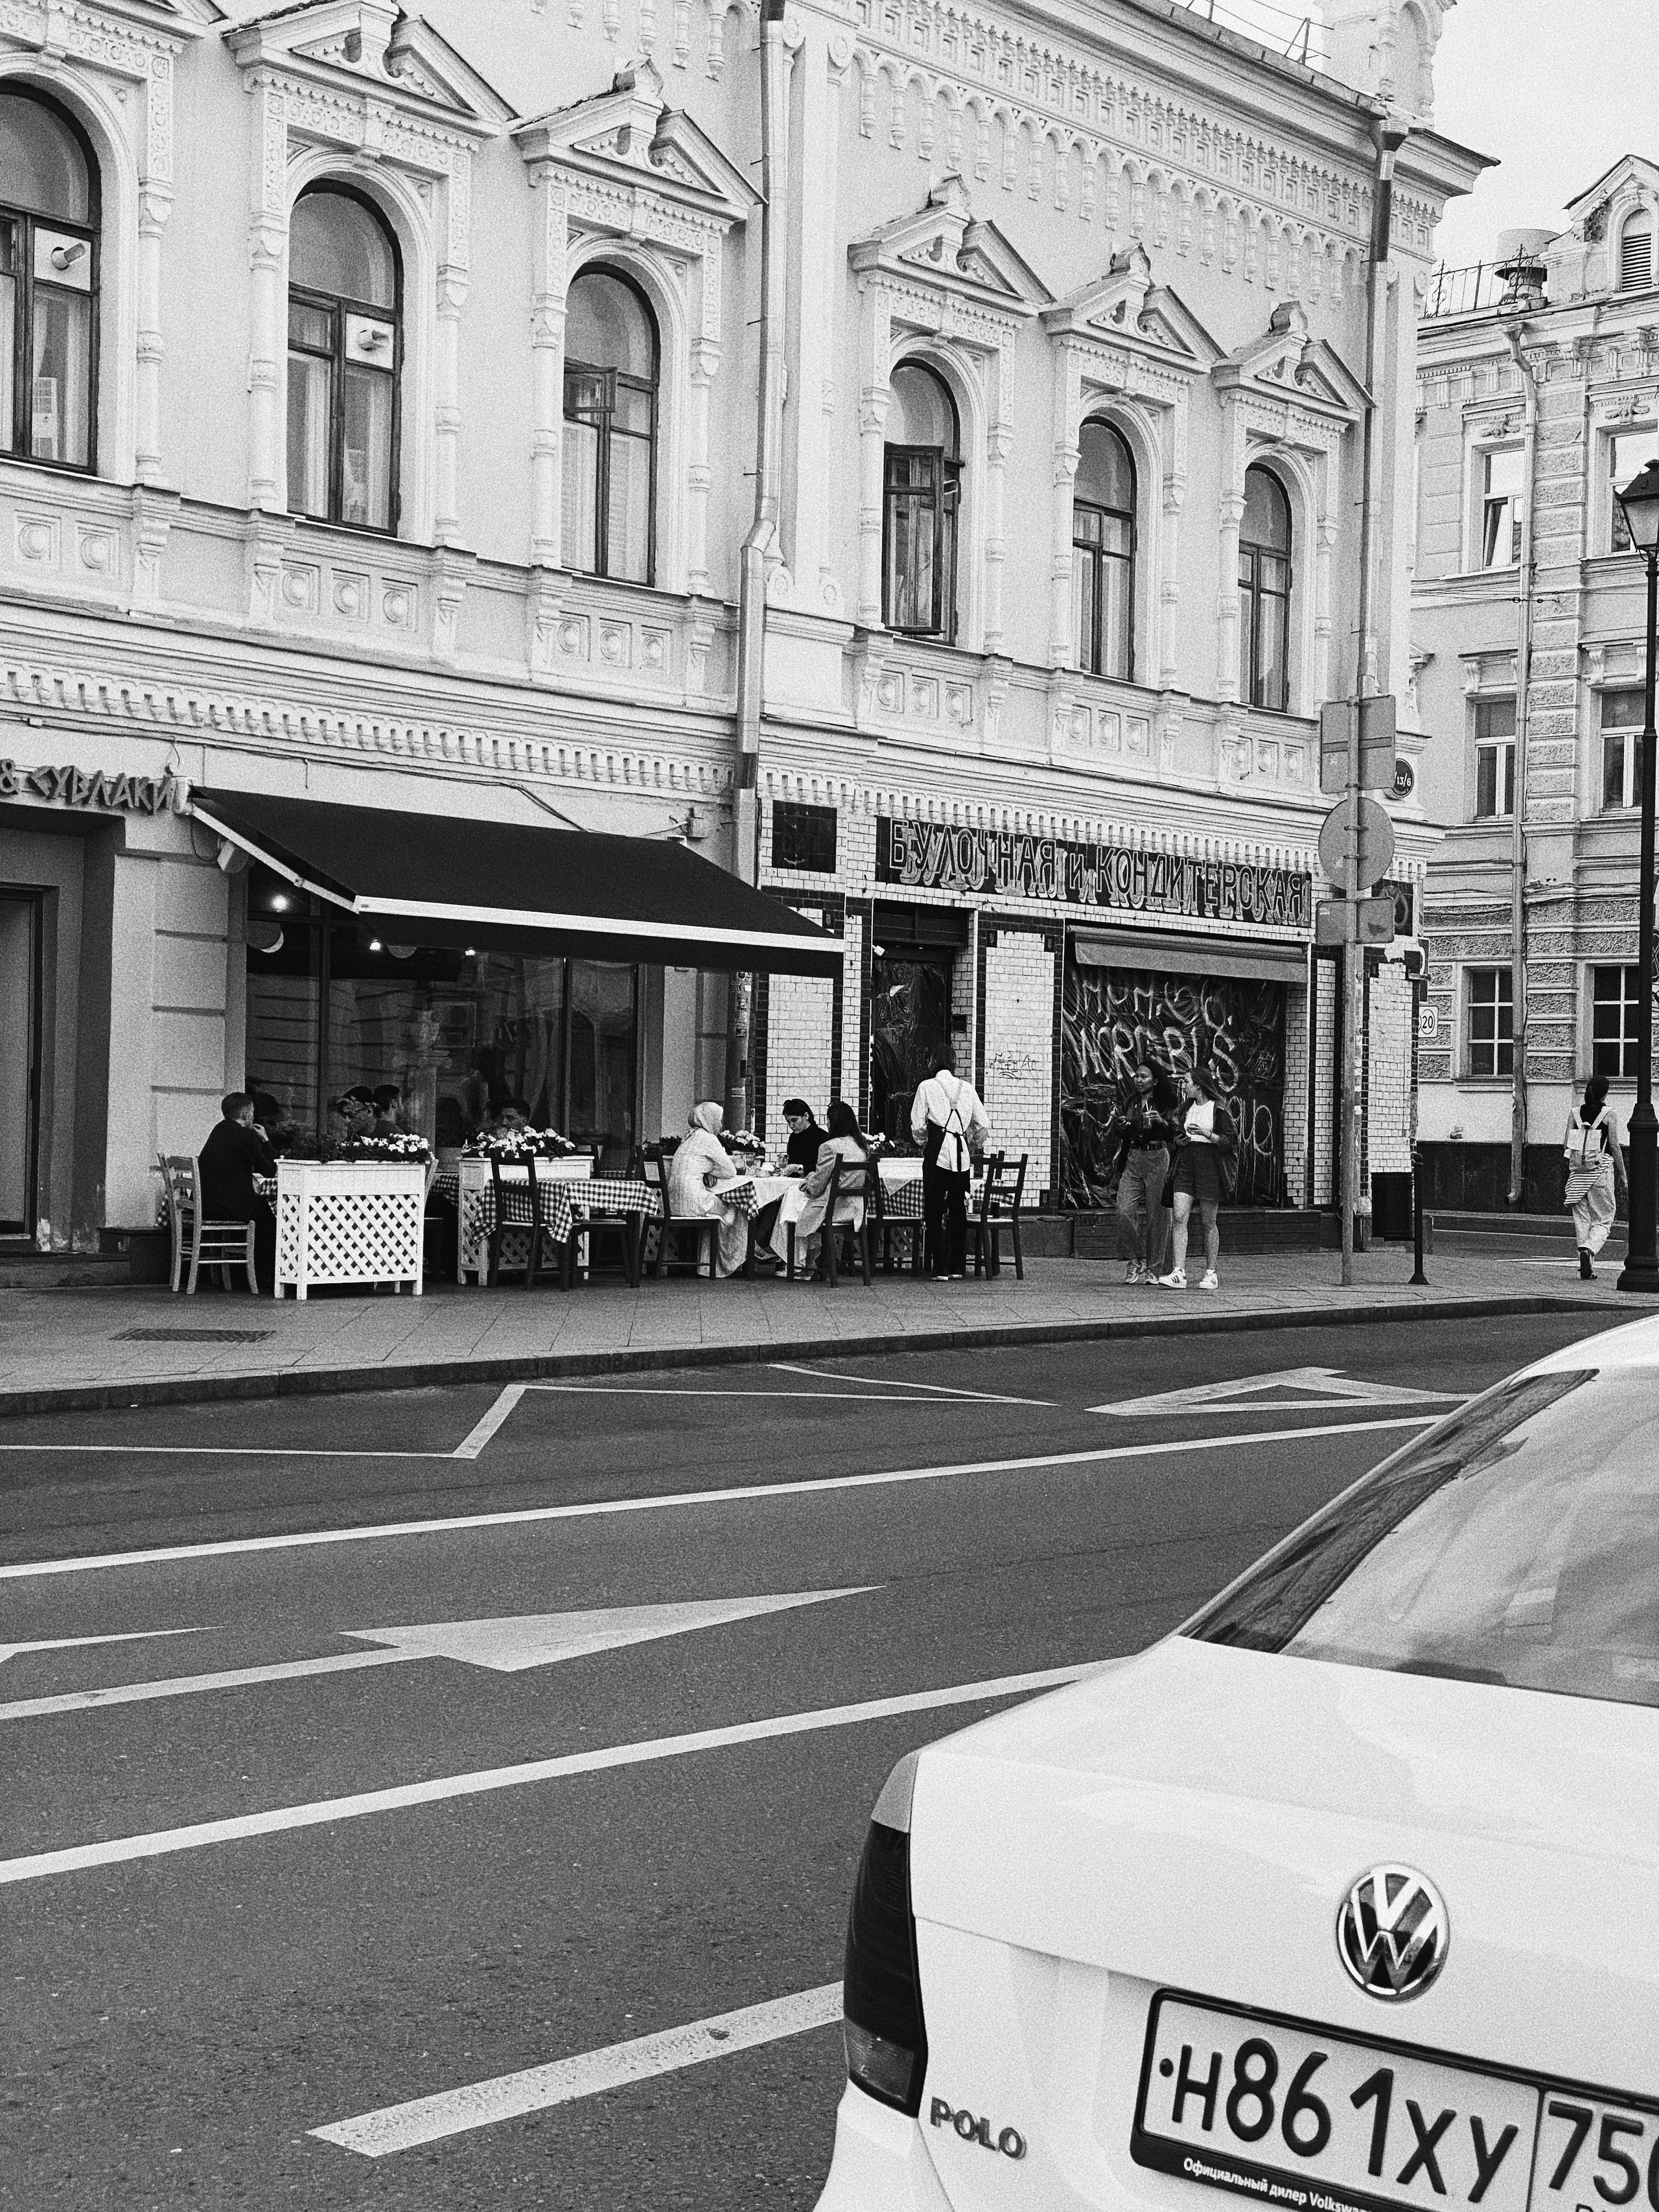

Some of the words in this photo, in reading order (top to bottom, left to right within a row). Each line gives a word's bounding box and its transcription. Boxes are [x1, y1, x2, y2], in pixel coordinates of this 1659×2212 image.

[890, 817, 1058, 896] БУЛОЧНАЯ
[1096, 846, 1304, 919] КОНДИТЕРСКАЯ
[1422, 1016, 1433, 1029] 20
[931, 2096, 1027, 2160] POLO
[1548, 2100, 1659, 2212] 75
[1183, 2157, 1268, 2193] Официальный
[1269, 2184, 1307, 2206] дилер
